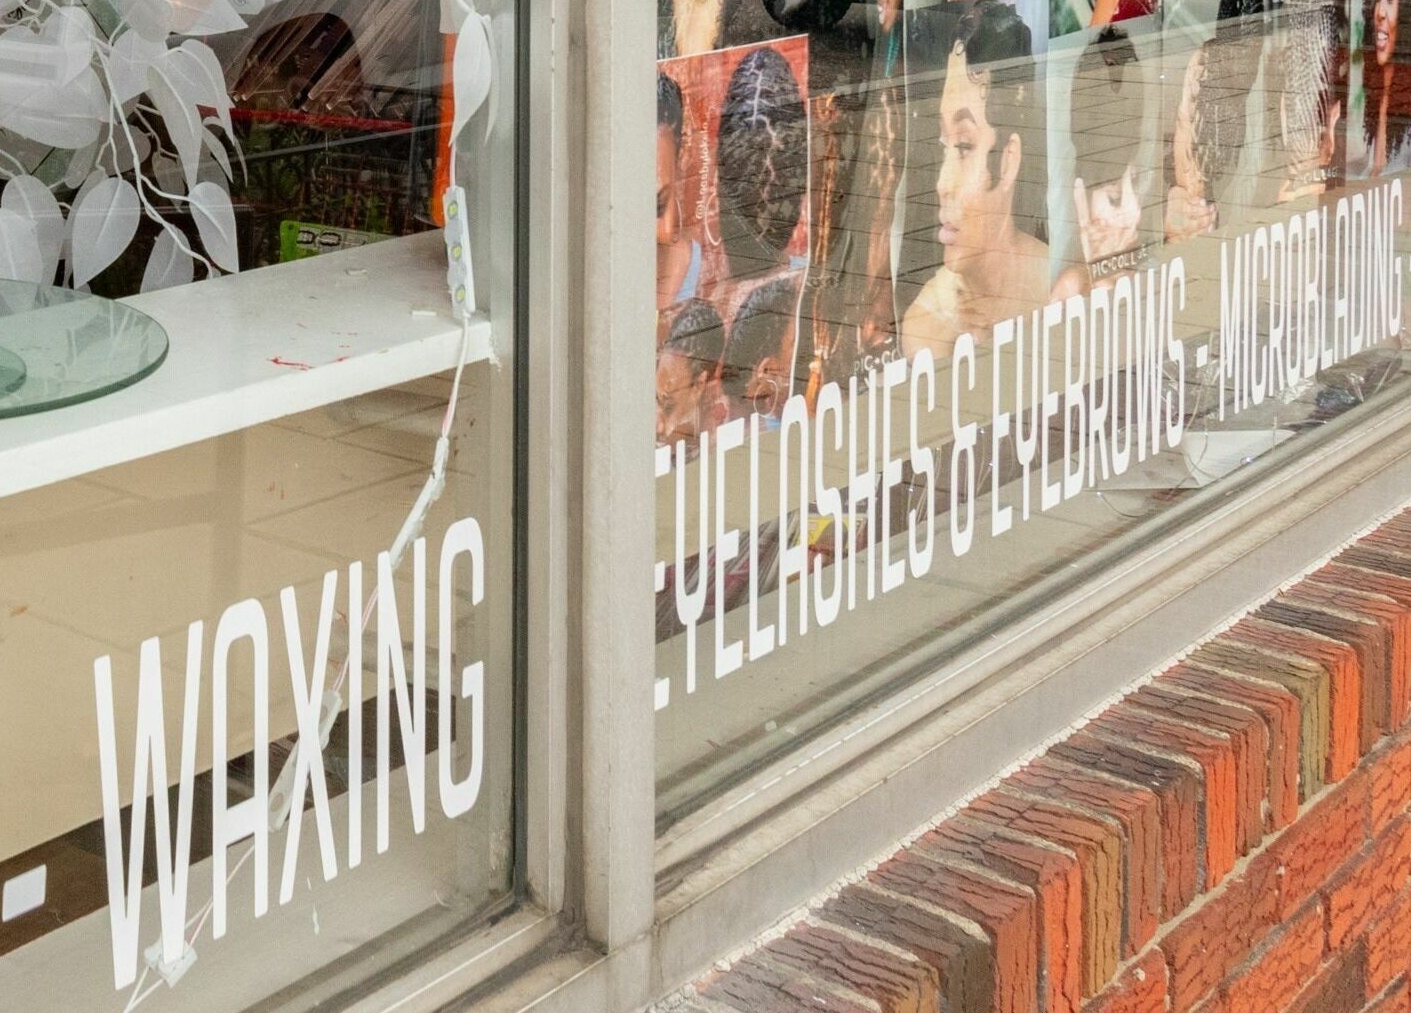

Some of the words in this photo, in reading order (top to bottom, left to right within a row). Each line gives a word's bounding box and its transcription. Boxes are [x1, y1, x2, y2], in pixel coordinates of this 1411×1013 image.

[950, 332, 978, 557] &
[992, 256, 1185, 537] EYEBROWS
[1216, 178, 1403, 421] MICROBLADING
[93, 517, 485, 990] WAXING
